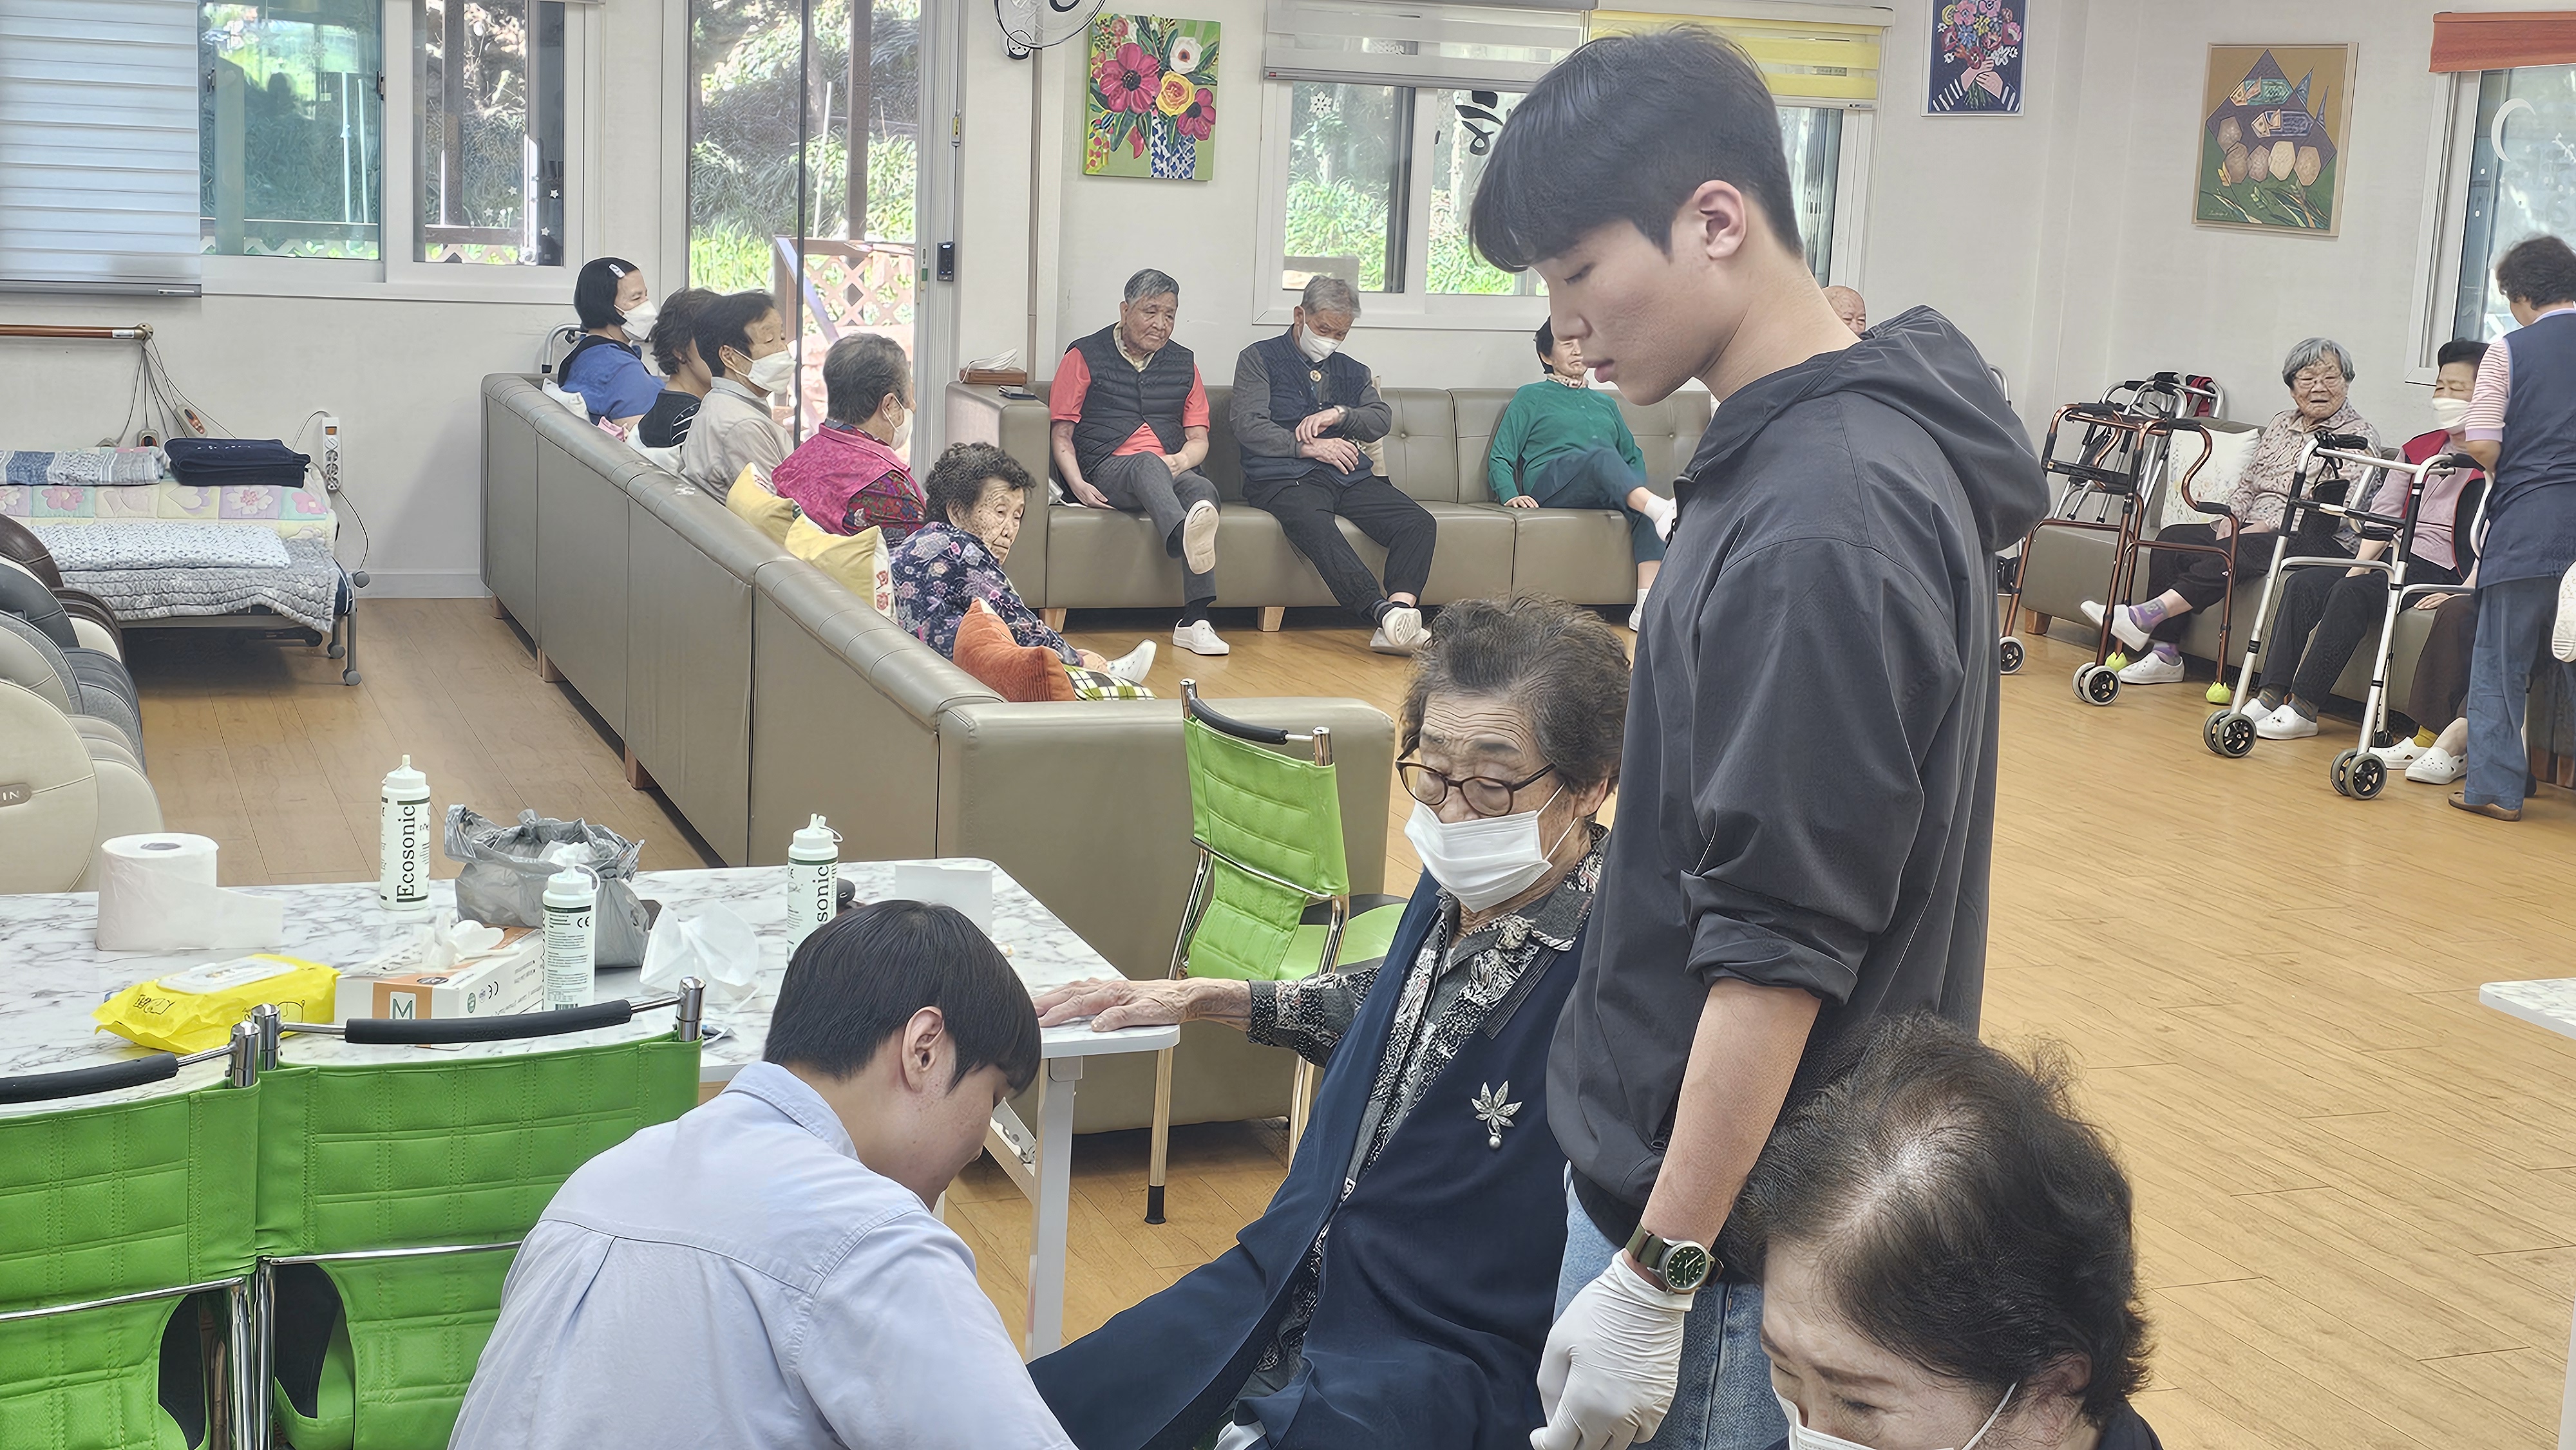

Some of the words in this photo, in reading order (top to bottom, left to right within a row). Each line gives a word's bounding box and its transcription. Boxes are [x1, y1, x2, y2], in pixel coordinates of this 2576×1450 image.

[397, 805, 415, 897] Ecosonic
[812, 865, 829, 922] sonic
[392, 997, 413, 1019] M
